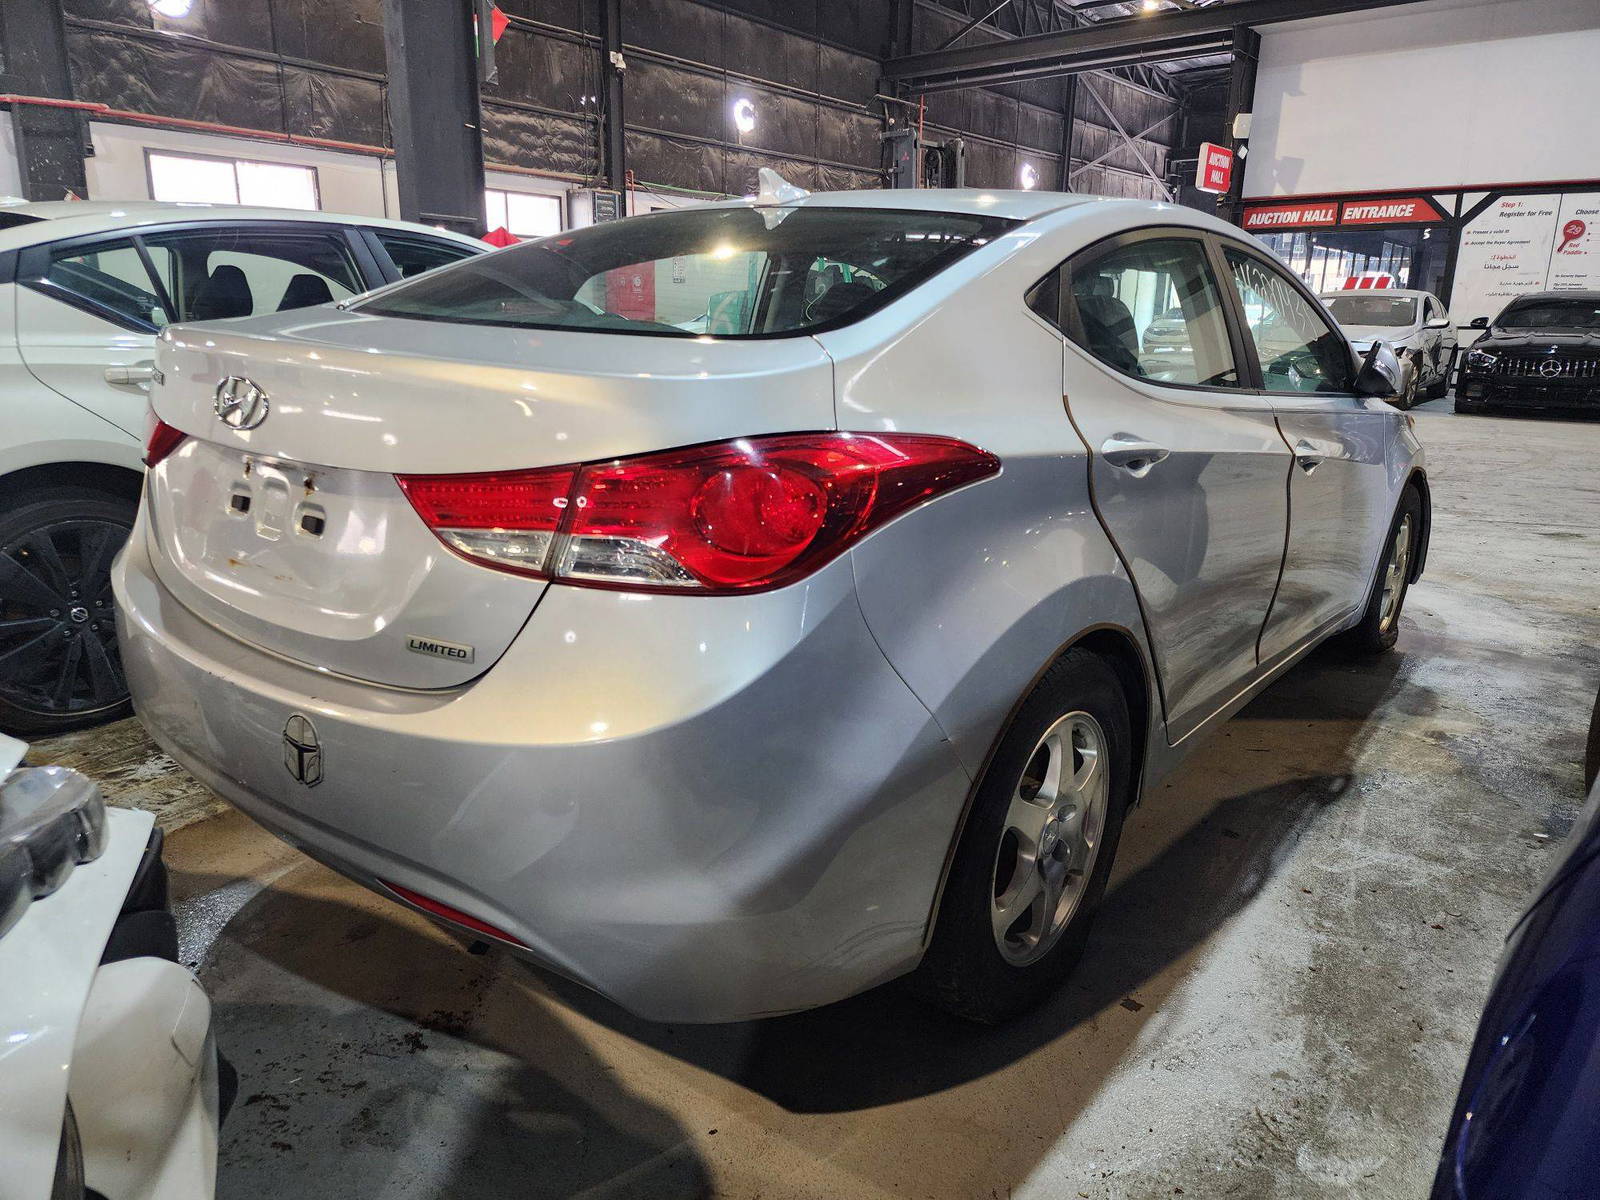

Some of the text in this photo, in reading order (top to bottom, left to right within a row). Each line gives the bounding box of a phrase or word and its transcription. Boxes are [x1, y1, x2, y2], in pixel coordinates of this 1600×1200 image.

[1208, 151, 1230, 169] AUCTION
[1210, 170, 1224, 184] HALL
[1501, 201, 1516, 209] Step
[1575, 208, 1600, 216] Choose
[1248, 204, 1416, 225] AUCTION HALL ENTRANCE
[409, 639, 467, 658] LIMITED
